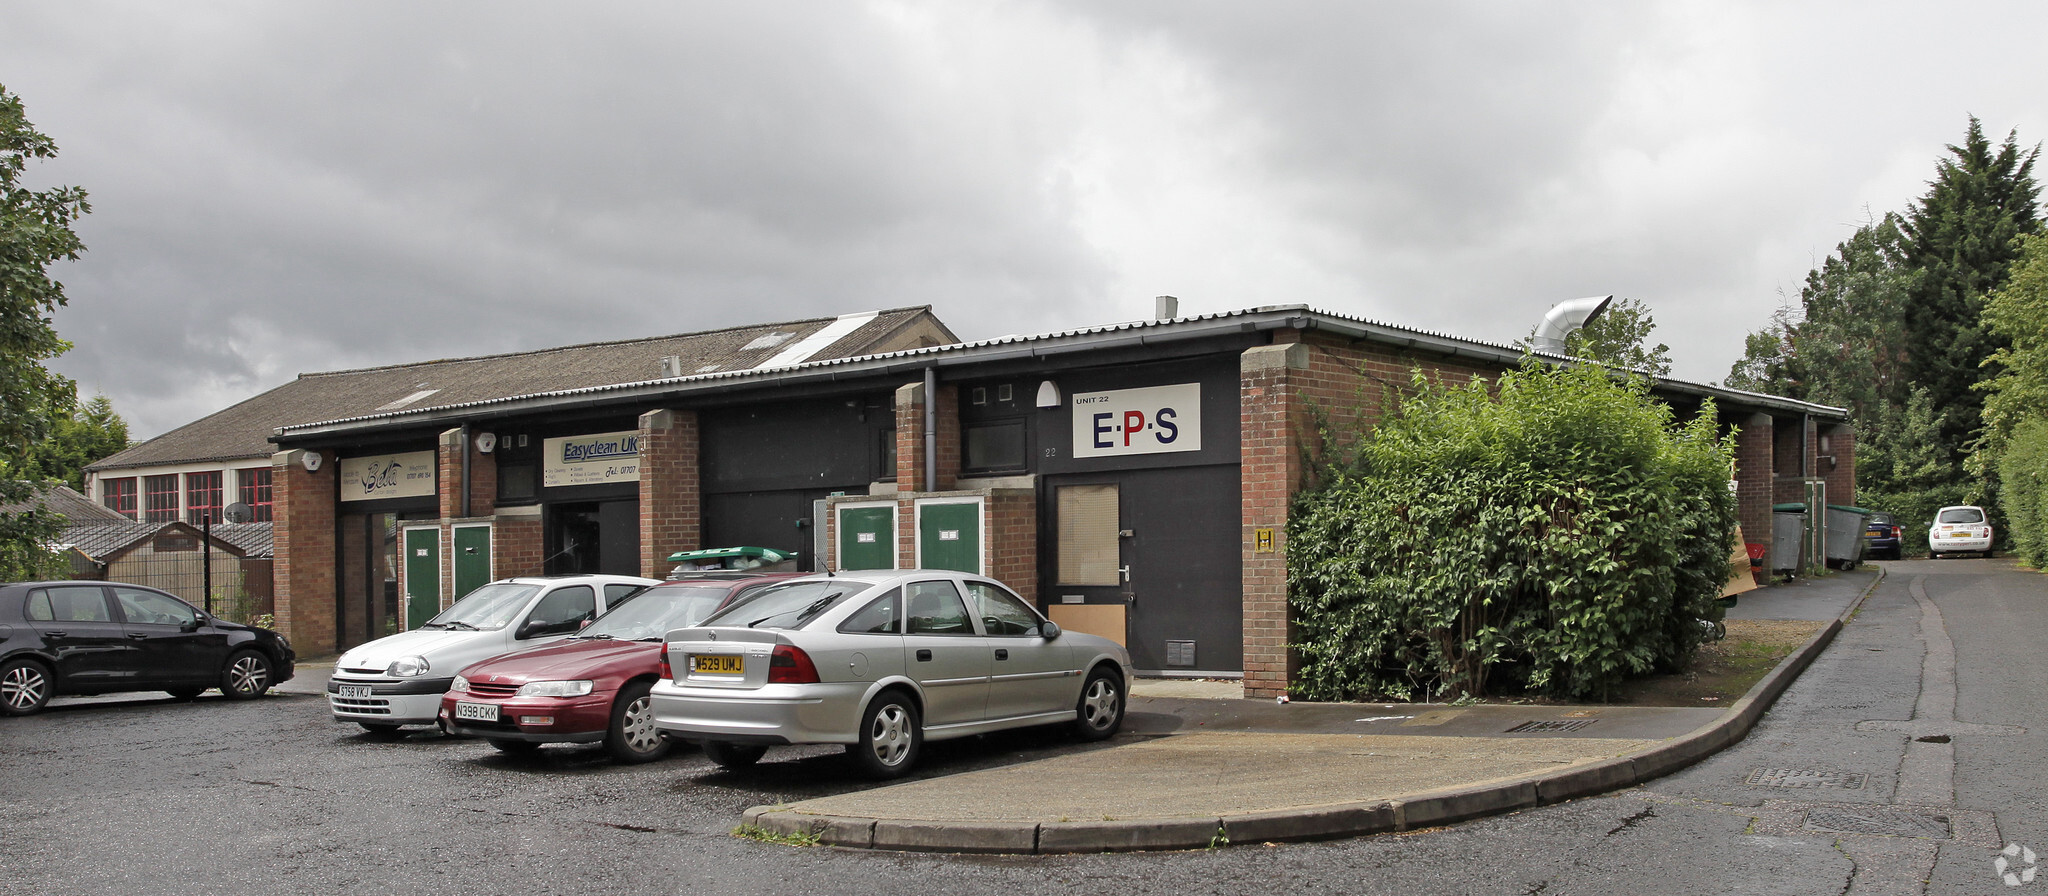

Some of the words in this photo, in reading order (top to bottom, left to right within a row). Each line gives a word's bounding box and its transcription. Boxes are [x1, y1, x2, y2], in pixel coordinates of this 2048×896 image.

[1076, 397, 1096, 405] UNIT
[564, 440, 618, 460] Easyclean
[621, 437, 638, 453] UK
[1045, 447, 1056, 457] 22
[696, 658, 720, 671] W529
[723, 659, 742, 671] UMJ
[340, 685, 355, 698] S758
[356, 685, 369, 698] VKJ
[457, 705, 477, 718] N398
[479, 706, 497, 719] CKK
